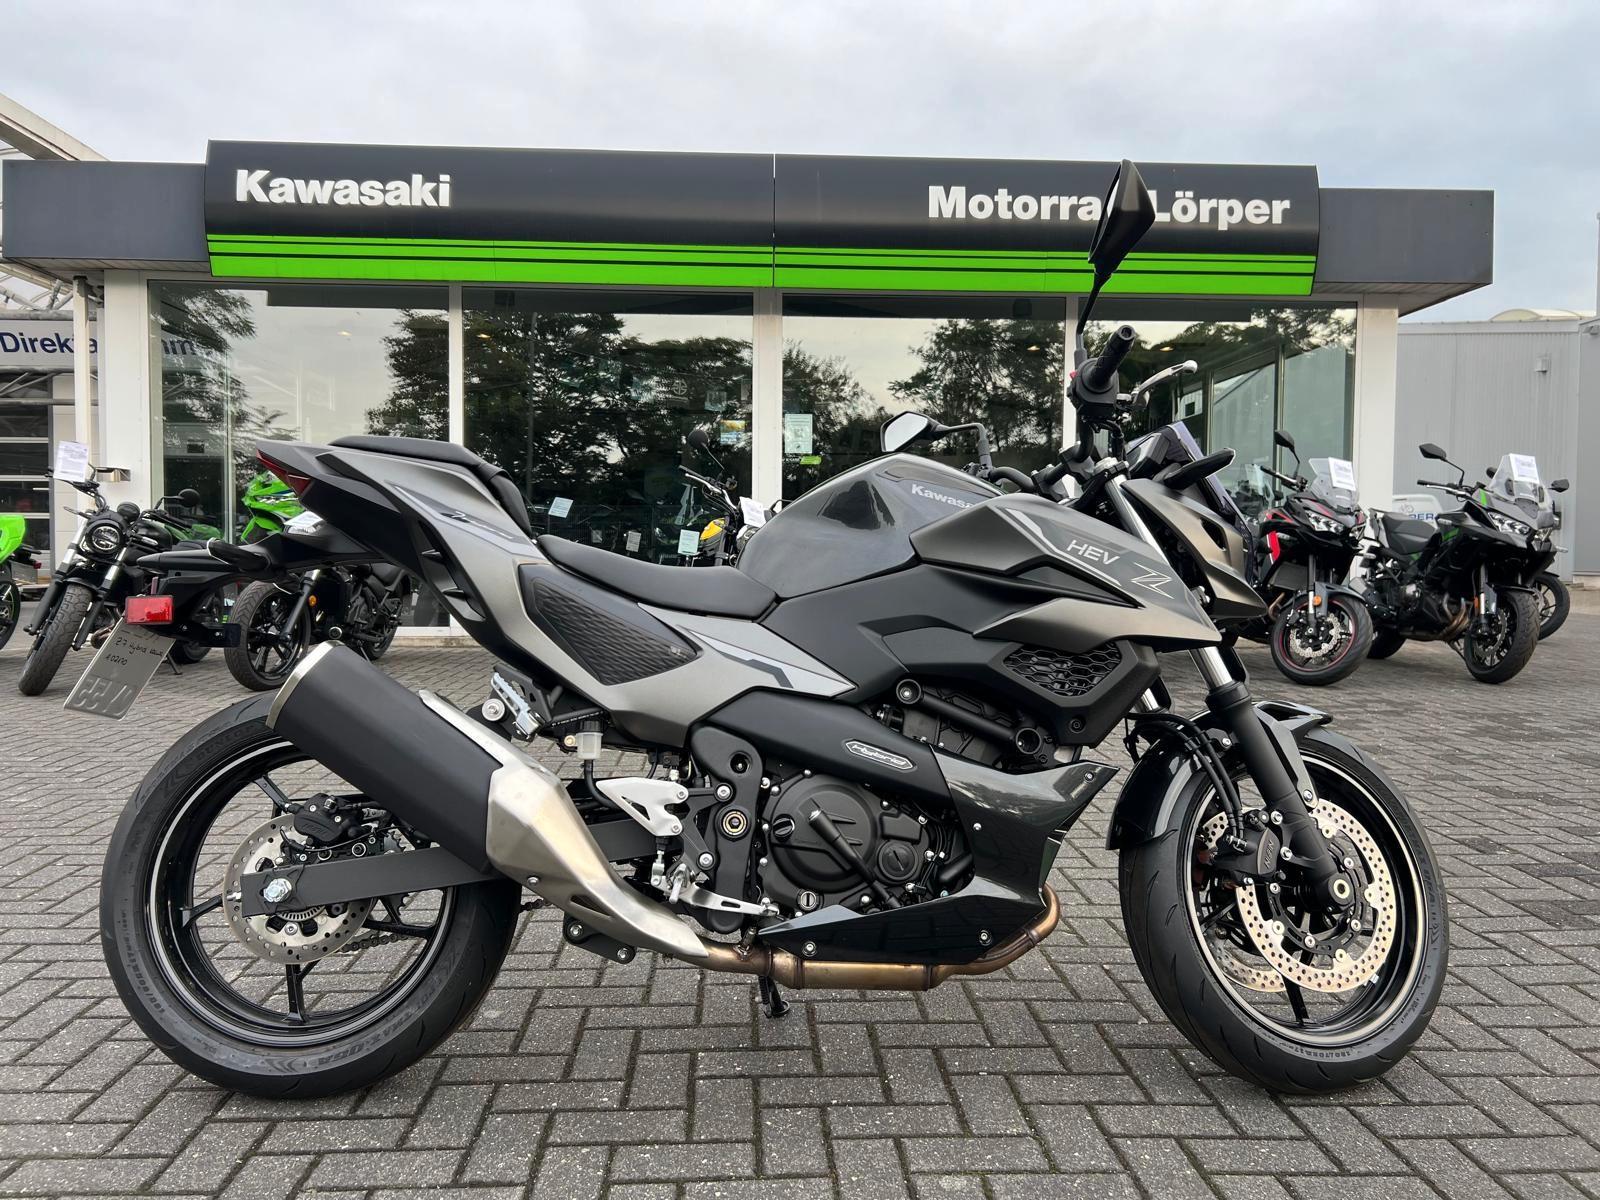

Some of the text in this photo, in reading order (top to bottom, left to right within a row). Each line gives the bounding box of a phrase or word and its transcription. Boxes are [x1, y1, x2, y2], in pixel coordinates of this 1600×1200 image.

[236, 169, 451, 207] Kawasaki
[928, 185, 1290, 231] Motorra Lörper
[1066, 539, 1121, 565] HEV
[851, 744, 907, 766] Hybrid
